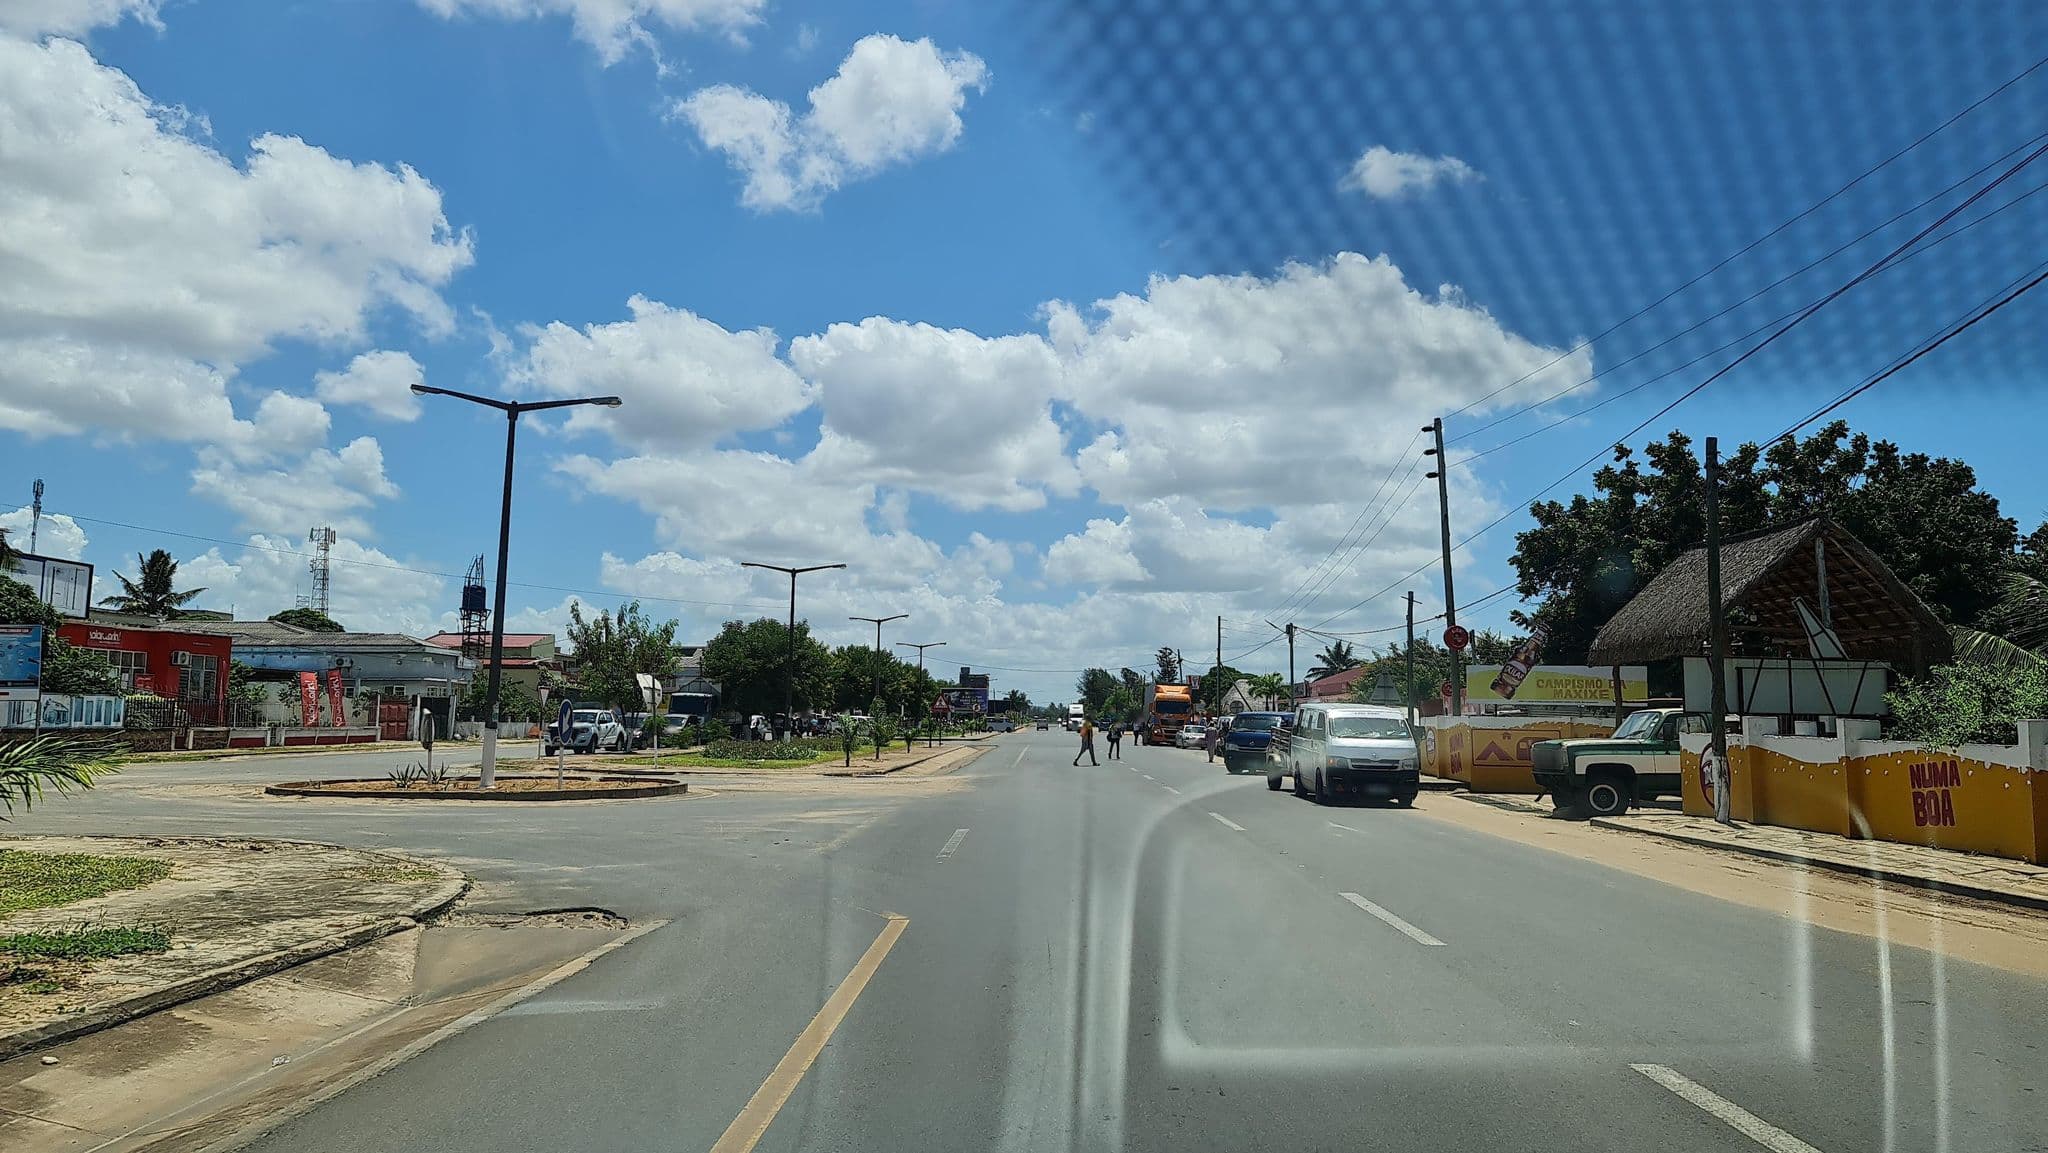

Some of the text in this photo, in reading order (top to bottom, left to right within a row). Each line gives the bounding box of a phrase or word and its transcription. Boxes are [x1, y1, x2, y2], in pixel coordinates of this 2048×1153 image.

[1536, 678, 1603, 689] CAMPISMO
[1553, 689, 1609, 699] MAXIXE
[1909, 759, 1962, 789] NUMA
[1911, 788, 1956, 827] BOA
